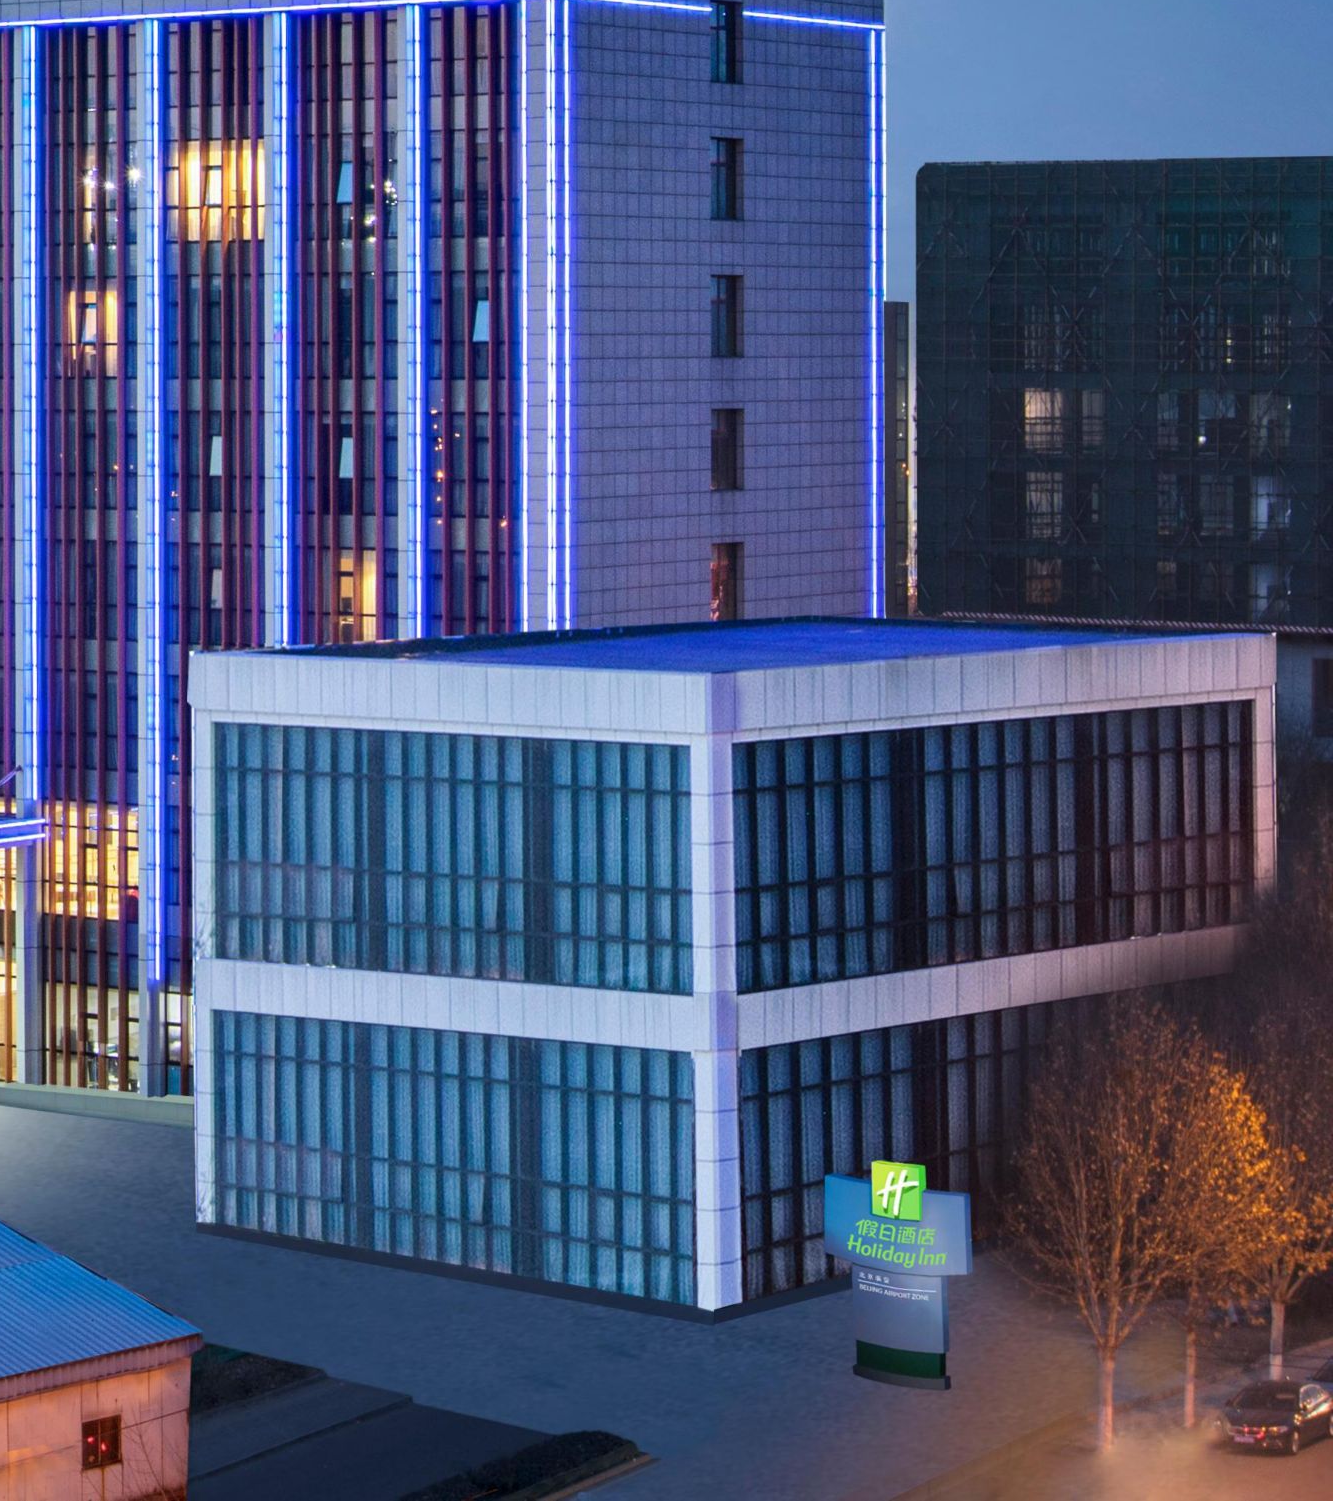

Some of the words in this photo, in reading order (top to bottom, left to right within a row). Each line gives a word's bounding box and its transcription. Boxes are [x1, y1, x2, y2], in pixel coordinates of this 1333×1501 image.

[856, 1219, 937, 1246] 假日酒店
[847, 1234, 916, 1269] Holiday
[918, 1247, 948, 1266] Inn
[859, 1283, 883, 1295] BEIJING
[884, 1289, 911, 1299] AIRPORT
[912, 1293, 930, 1301] ZONE
